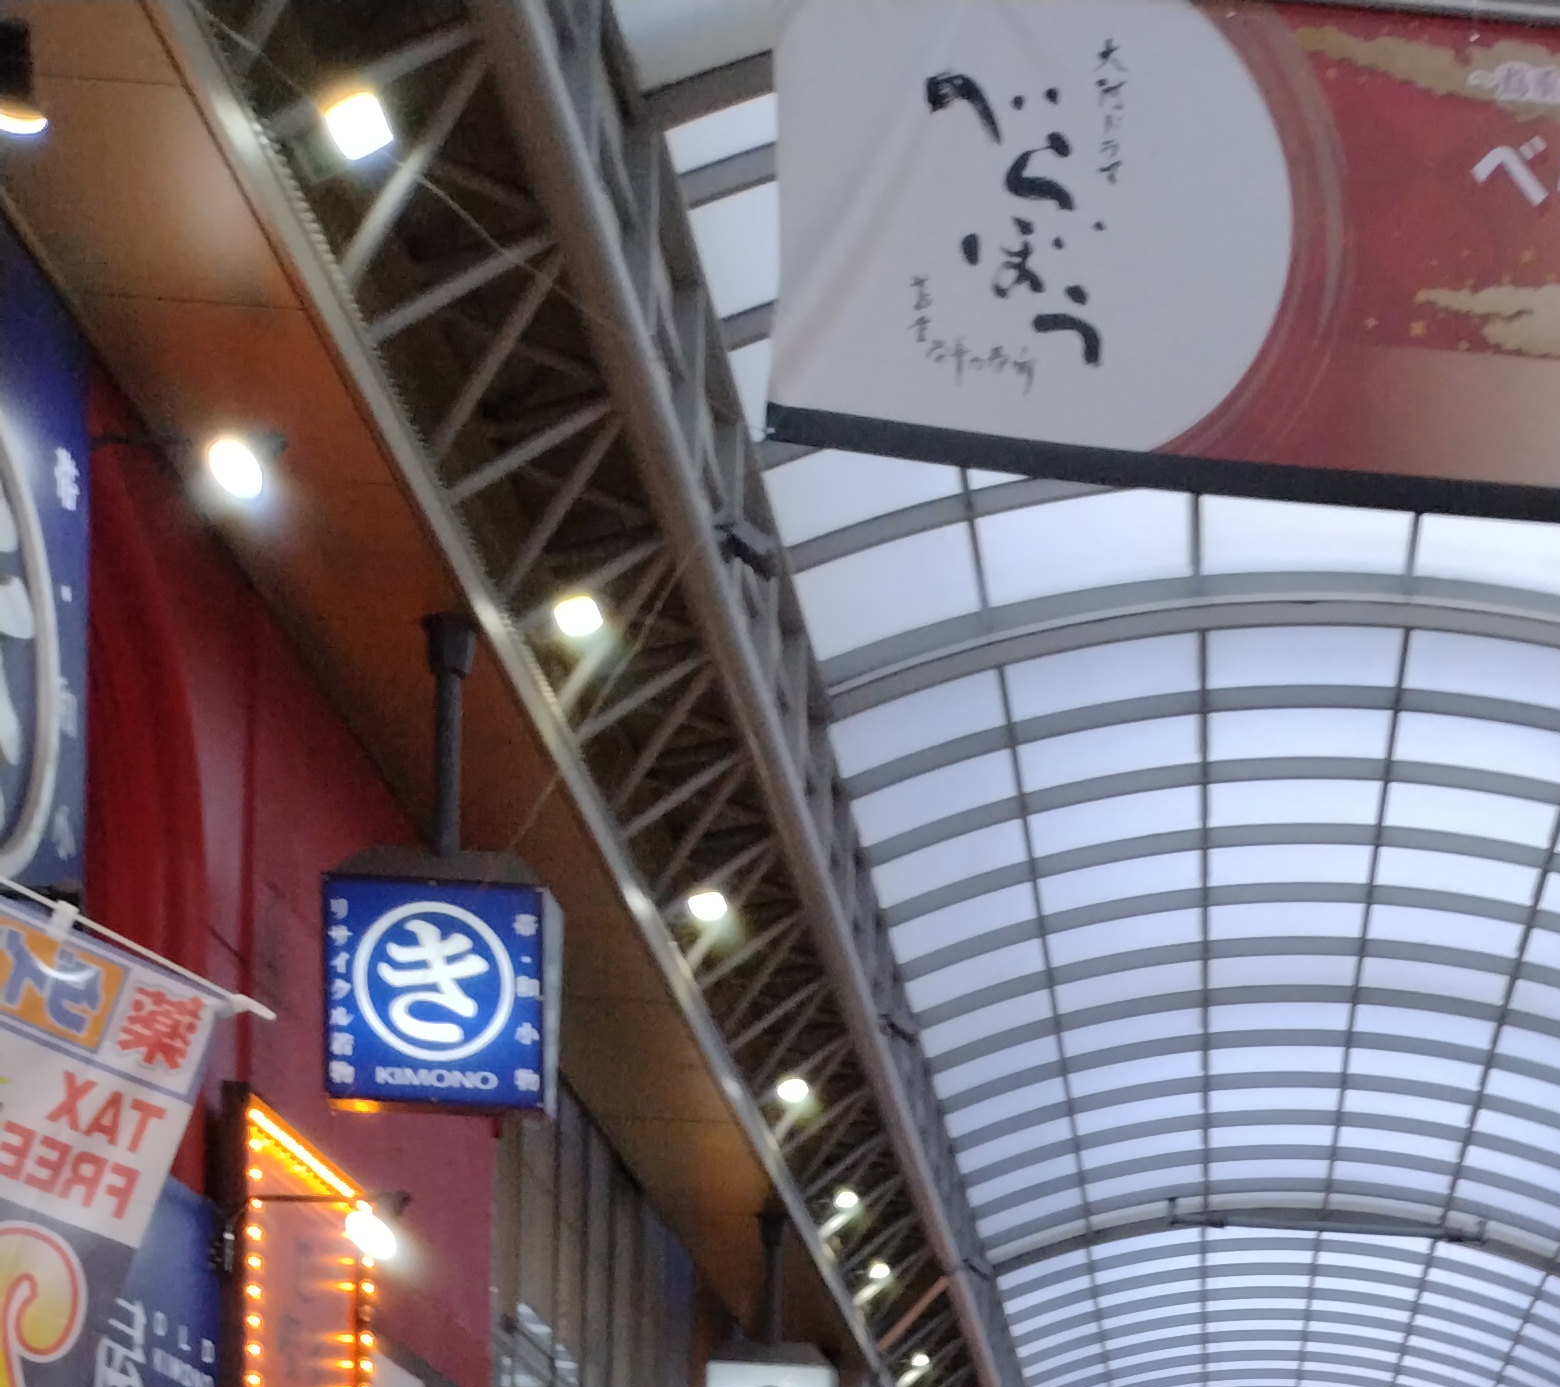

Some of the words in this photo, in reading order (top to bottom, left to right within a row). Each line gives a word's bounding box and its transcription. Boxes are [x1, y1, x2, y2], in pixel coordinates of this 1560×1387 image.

[924, 72, 1106, 367] べらぼう
[377, 919, 489, 1043] き
[375, 1065, 498, 1090] KIMONO
